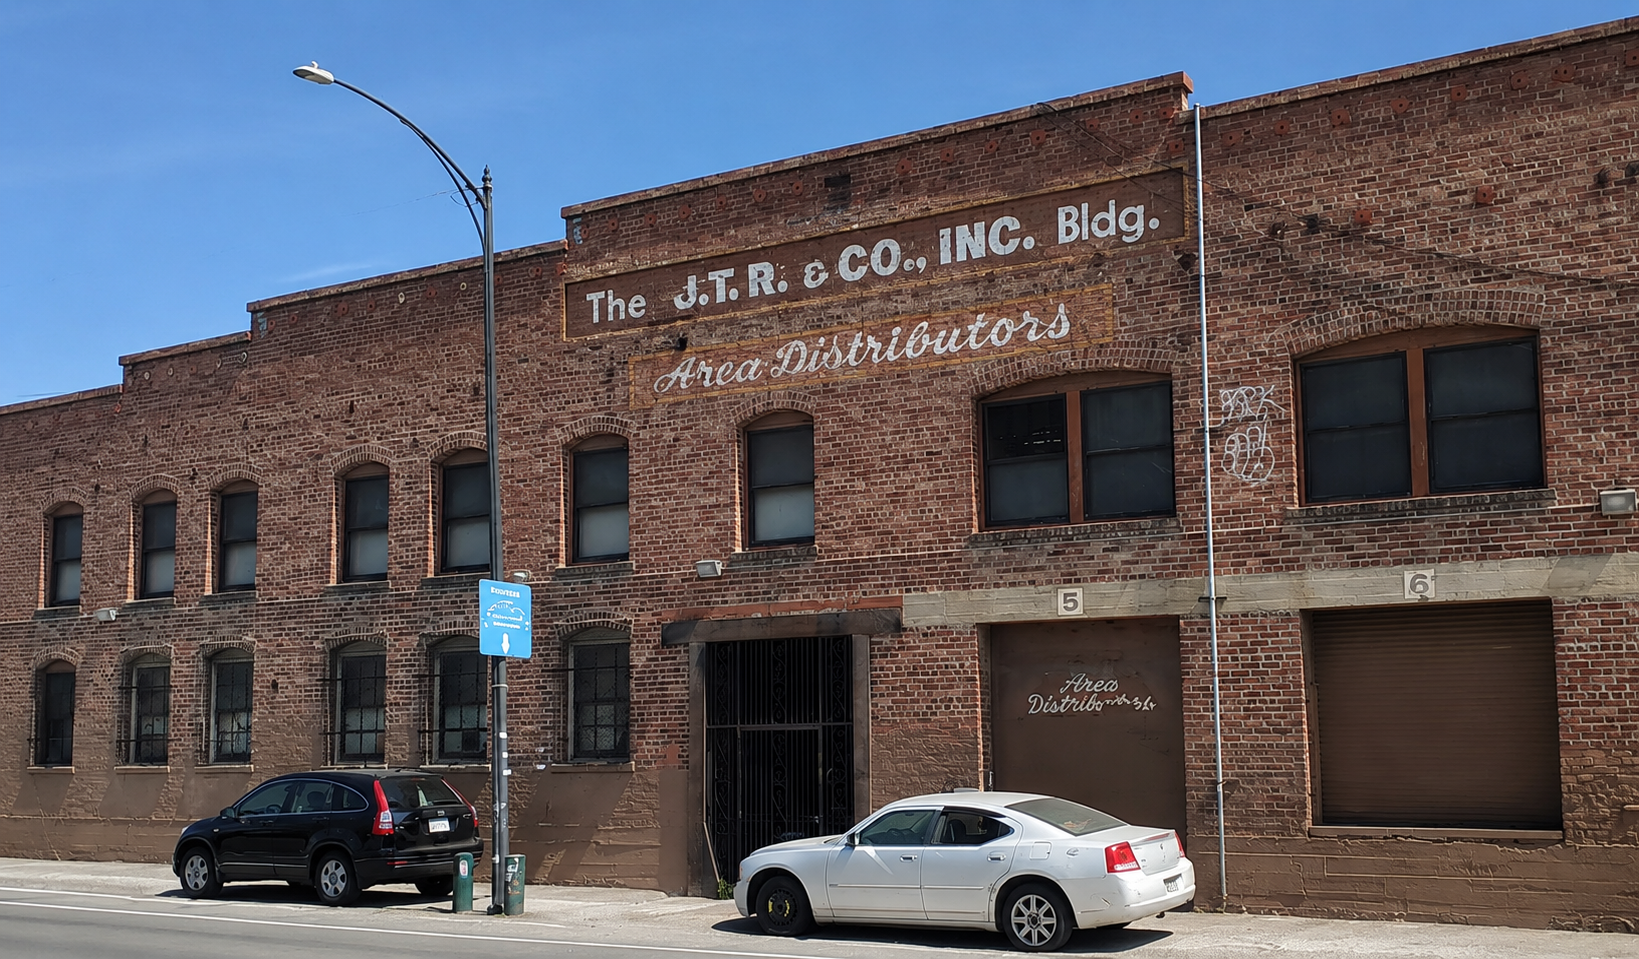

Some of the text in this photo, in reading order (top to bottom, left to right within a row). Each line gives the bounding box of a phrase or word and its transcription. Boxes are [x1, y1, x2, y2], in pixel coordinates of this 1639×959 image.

[586, 289, 647, 324] The
[803, 258, 829, 289] &
[838, 238, 928, 282] CO.,
[939, 215, 1036, 266] INC.
[1057, 199, 1160, 245] Bldg.
[653, 303, 1071, 393] Area Distributors
[1410, 573, 1430, 594] 6
[1062, 591, 1079, 612] 5
[1059, 672, 1120, 694] Area
